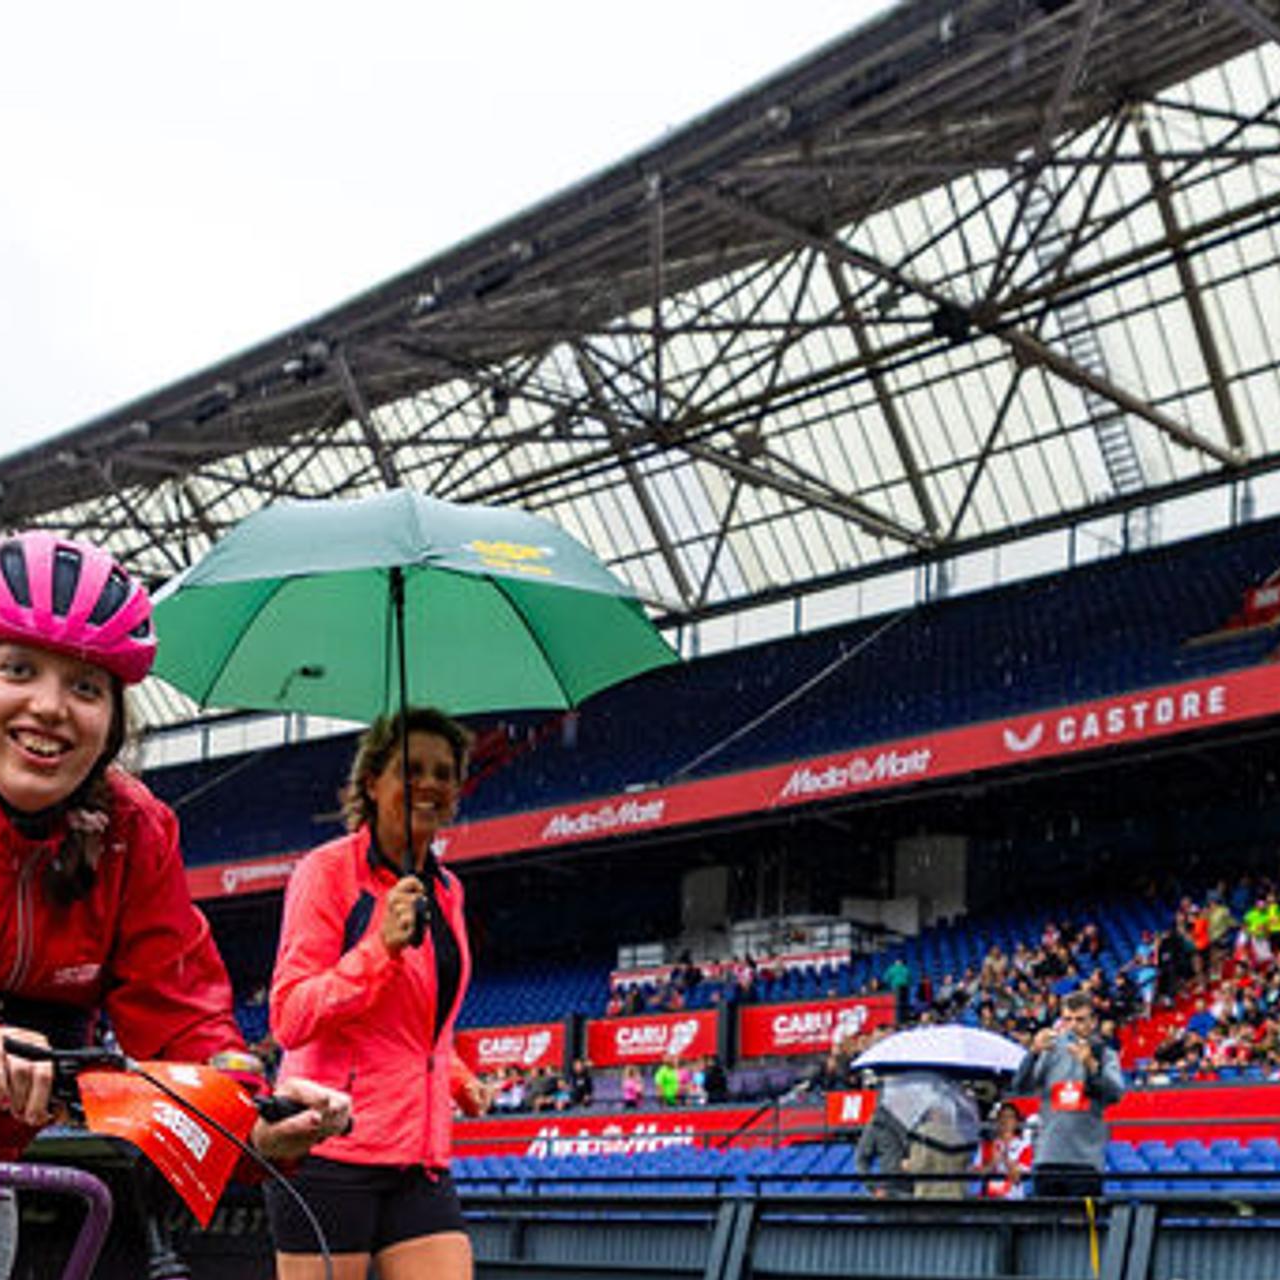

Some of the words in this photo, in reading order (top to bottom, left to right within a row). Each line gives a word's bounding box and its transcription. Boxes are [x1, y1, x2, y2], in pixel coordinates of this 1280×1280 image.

[1057, 685, 1228, 744] CASTORE
[771, 1009, 834, 1034] CARU
[478, 1036, 524, 1056] CARU
[616, 1024, 668, 1045] CARU
